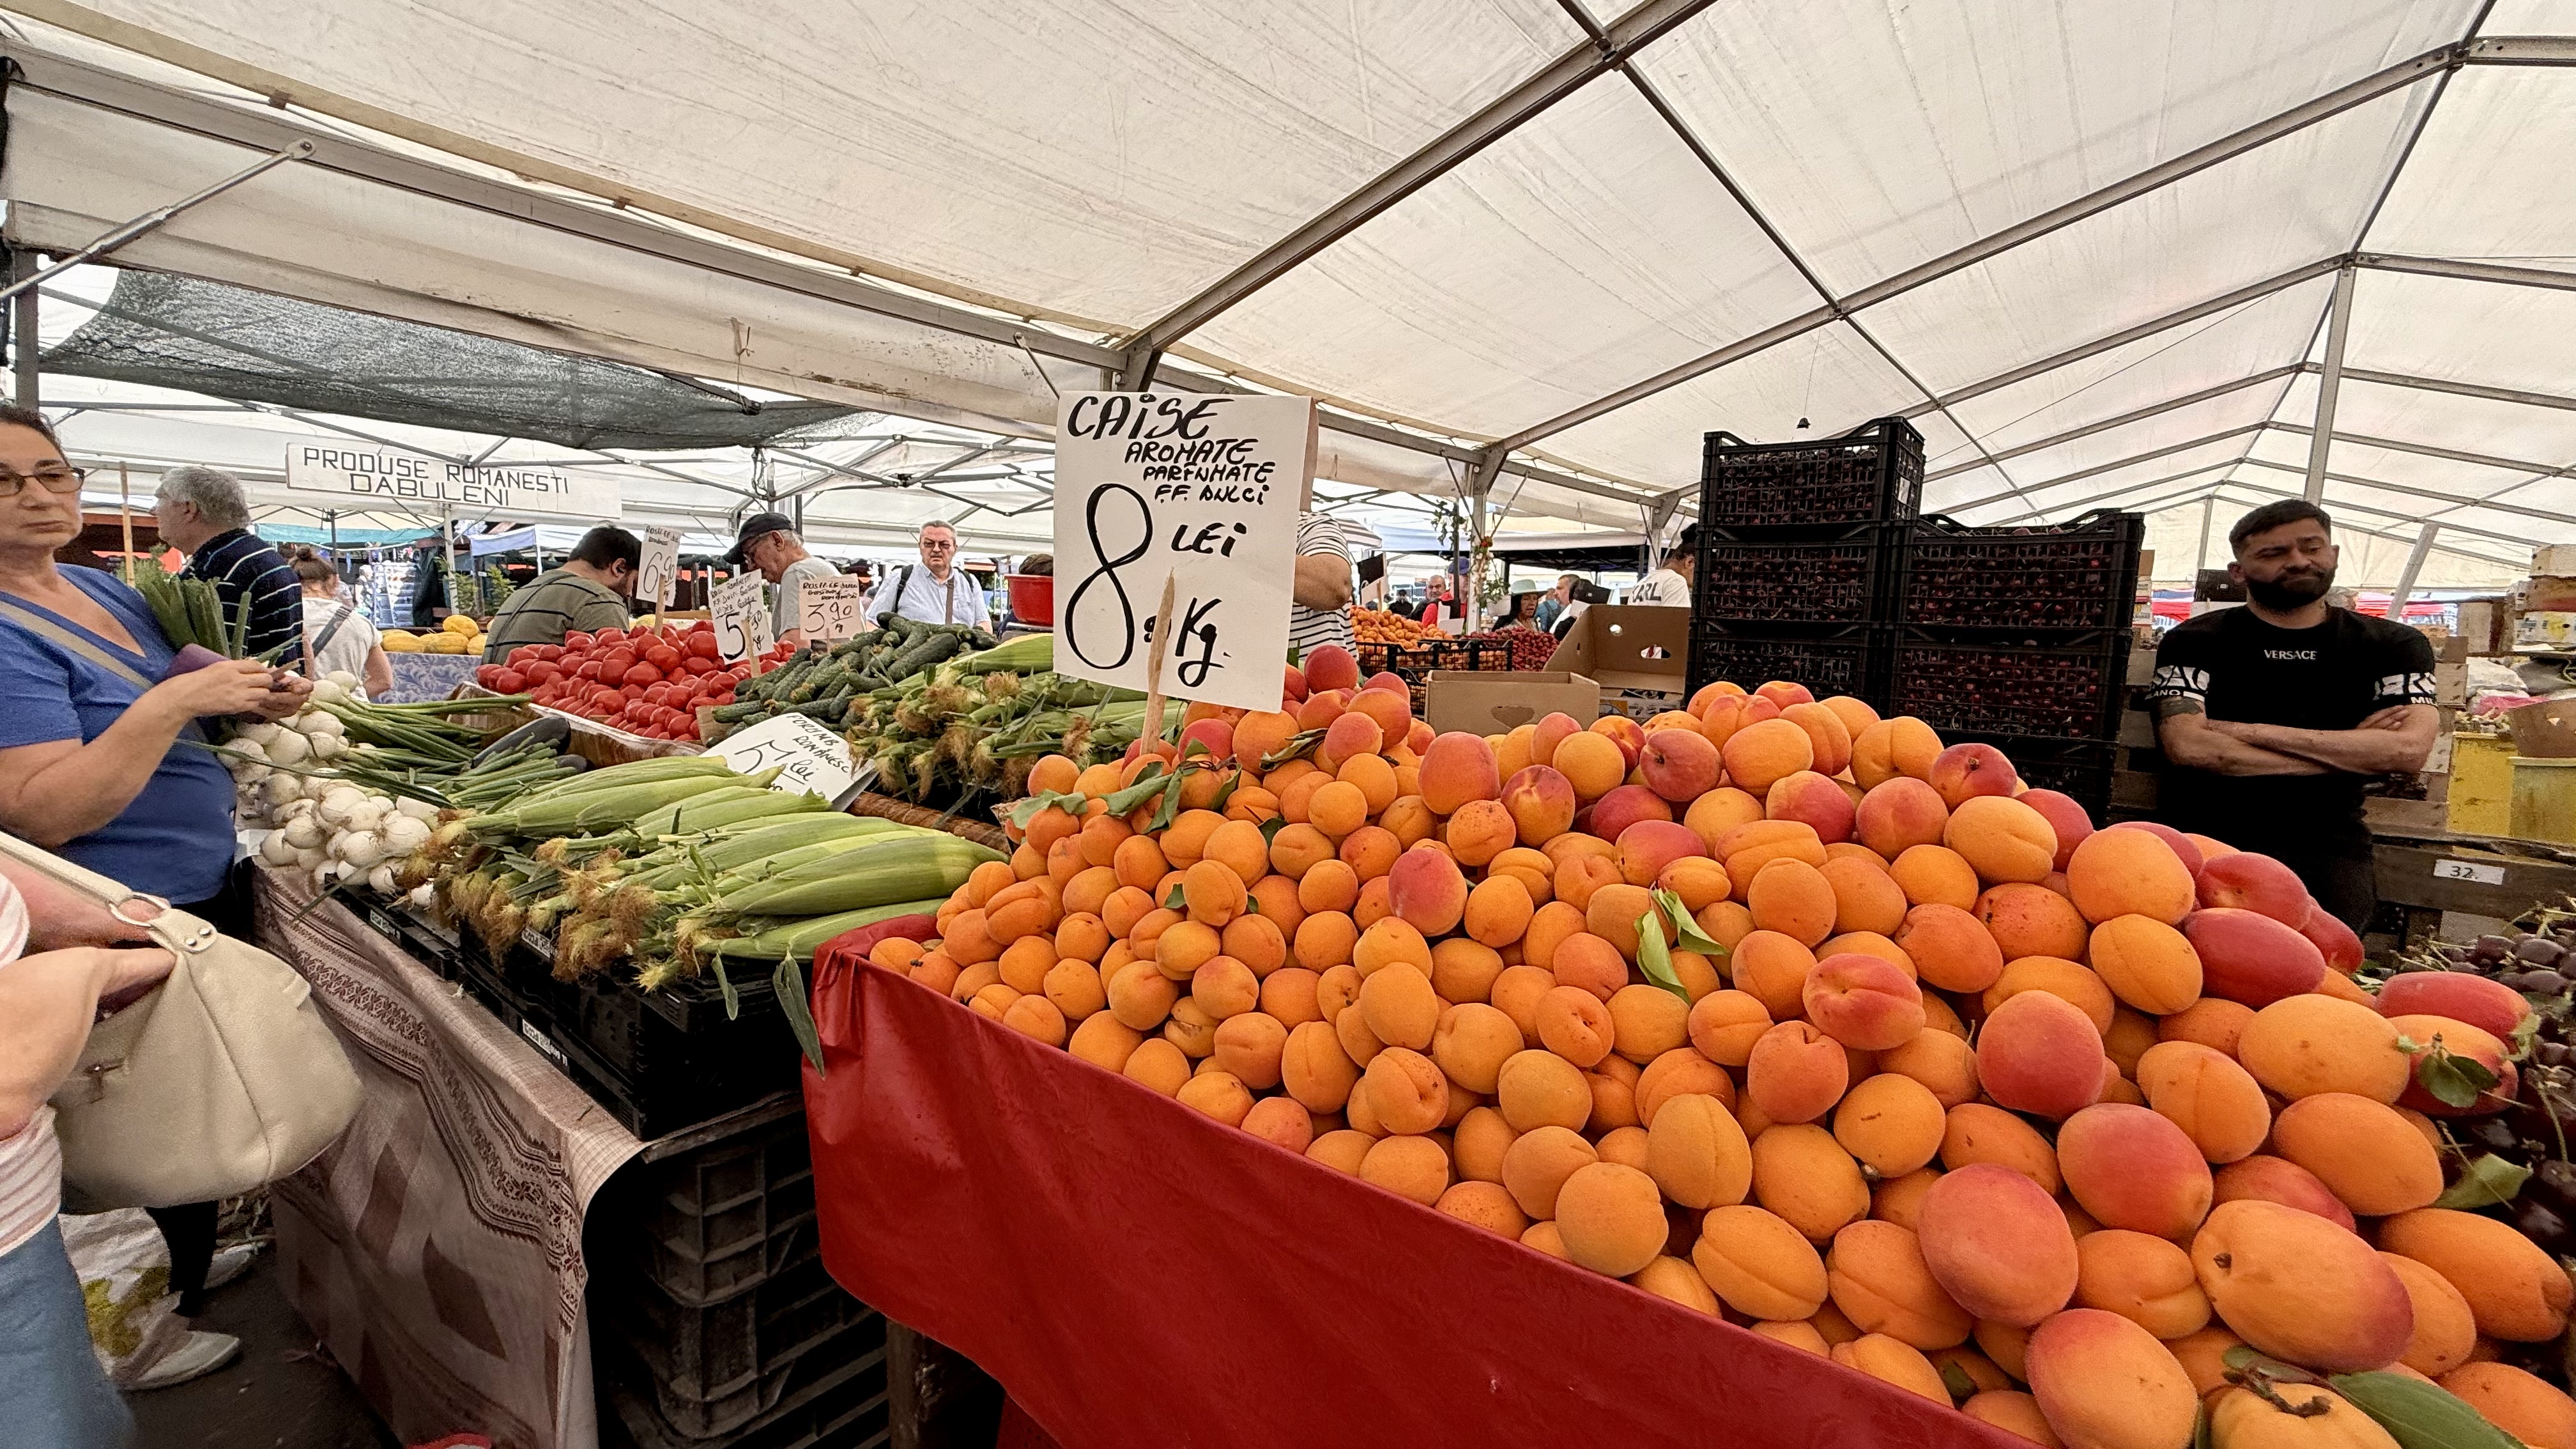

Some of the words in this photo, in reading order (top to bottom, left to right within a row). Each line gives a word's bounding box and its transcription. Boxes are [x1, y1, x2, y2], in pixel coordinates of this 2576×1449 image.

[303, 447, 429, 479] PRODUSE
[445, 464, 569, 494] ROMANESTI
[349, 473, 509, 507] DABULENI
[643, 551, 663, 594] 6
[1064, 483, 1153, 670] 8
[723, 611, 746, 661] 5
[805, 602, 825, 633] 3
[2263, 649, 2319, 661] VERSACE
[785, 714, 839, 747] PORUMB
